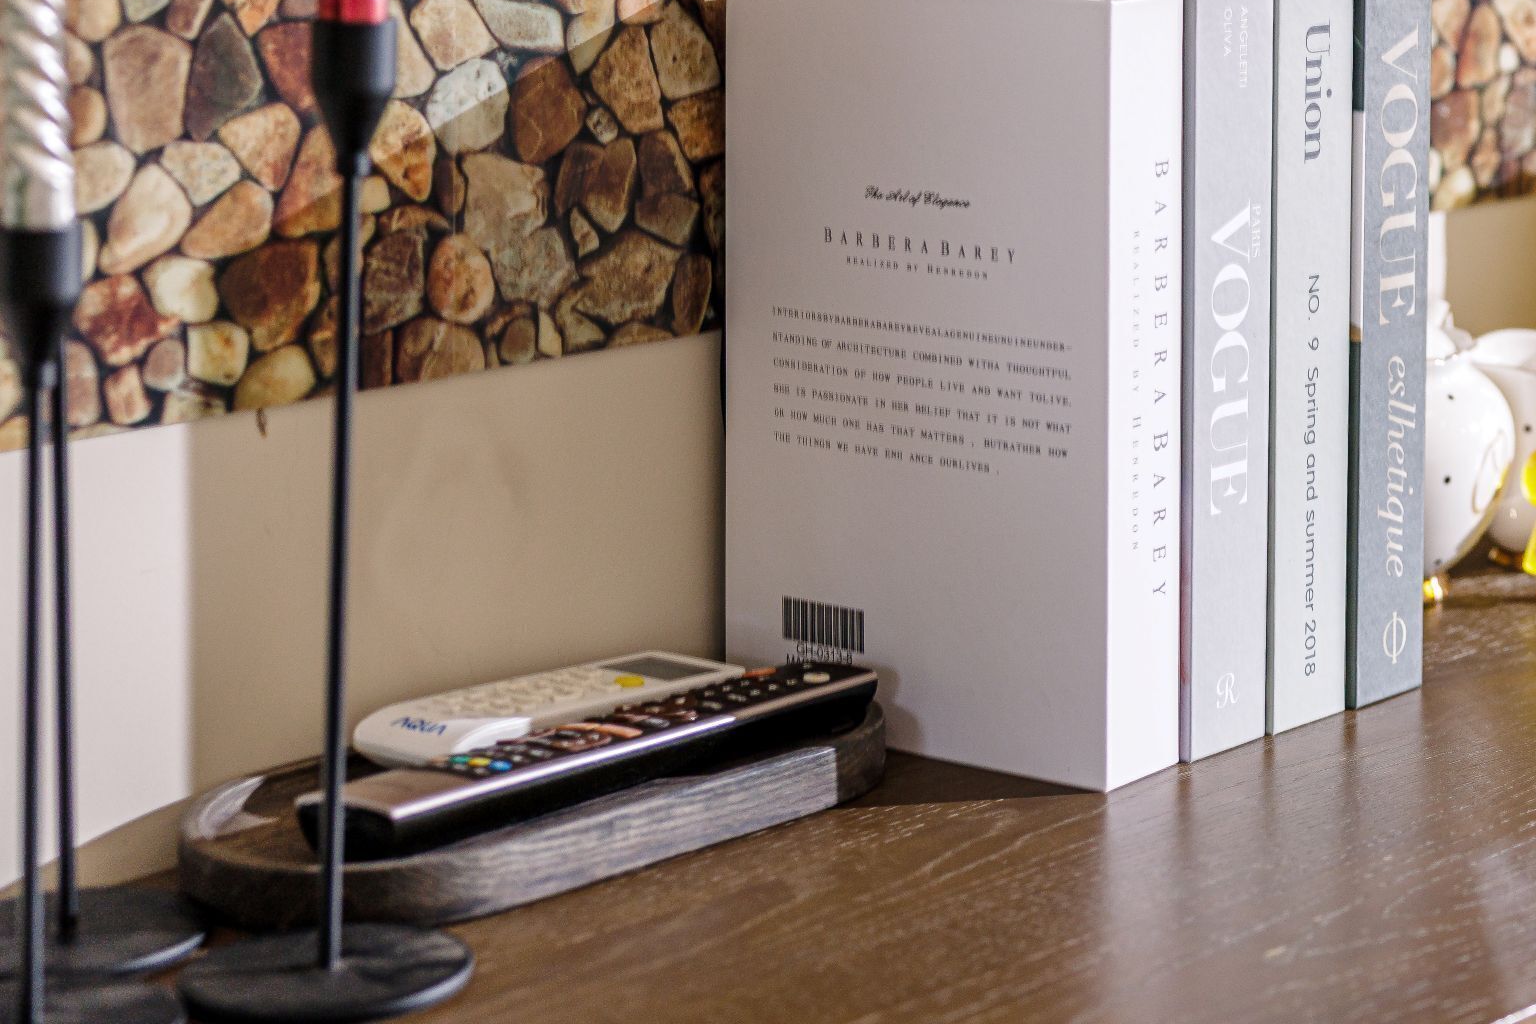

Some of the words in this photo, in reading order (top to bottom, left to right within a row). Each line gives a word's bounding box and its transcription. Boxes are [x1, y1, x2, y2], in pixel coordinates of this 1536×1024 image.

[1224, 8, 1232, 56] OLIVA
[1240, 7, 1248, 87] ANGELETTI
[1304, 21, 1332, 164] Union
[909, 191, 921, 207] of
[1380, 21, 1420, 325] VOGUE
[824, 227, 928, 254] BARBERA
[940, 240, 1015, 264] BAREY
[1252, 206, 1260, 257] PARIS
[1153, 161, 1169, 404] BARBERA
[1308, 275, 1319, 320] NO.
[1210, 200, 1250, 515] VOGUE
[1308, 337, 1319, 351] 9
[1304, 367, 1318, 445] Spring
[1307, 453, 1318, 501] and
[1153, 430, 1168, 595] BAREY
[1305, 510, 1314, 611] summer
[1305, 620, 1316, 676] 2018
